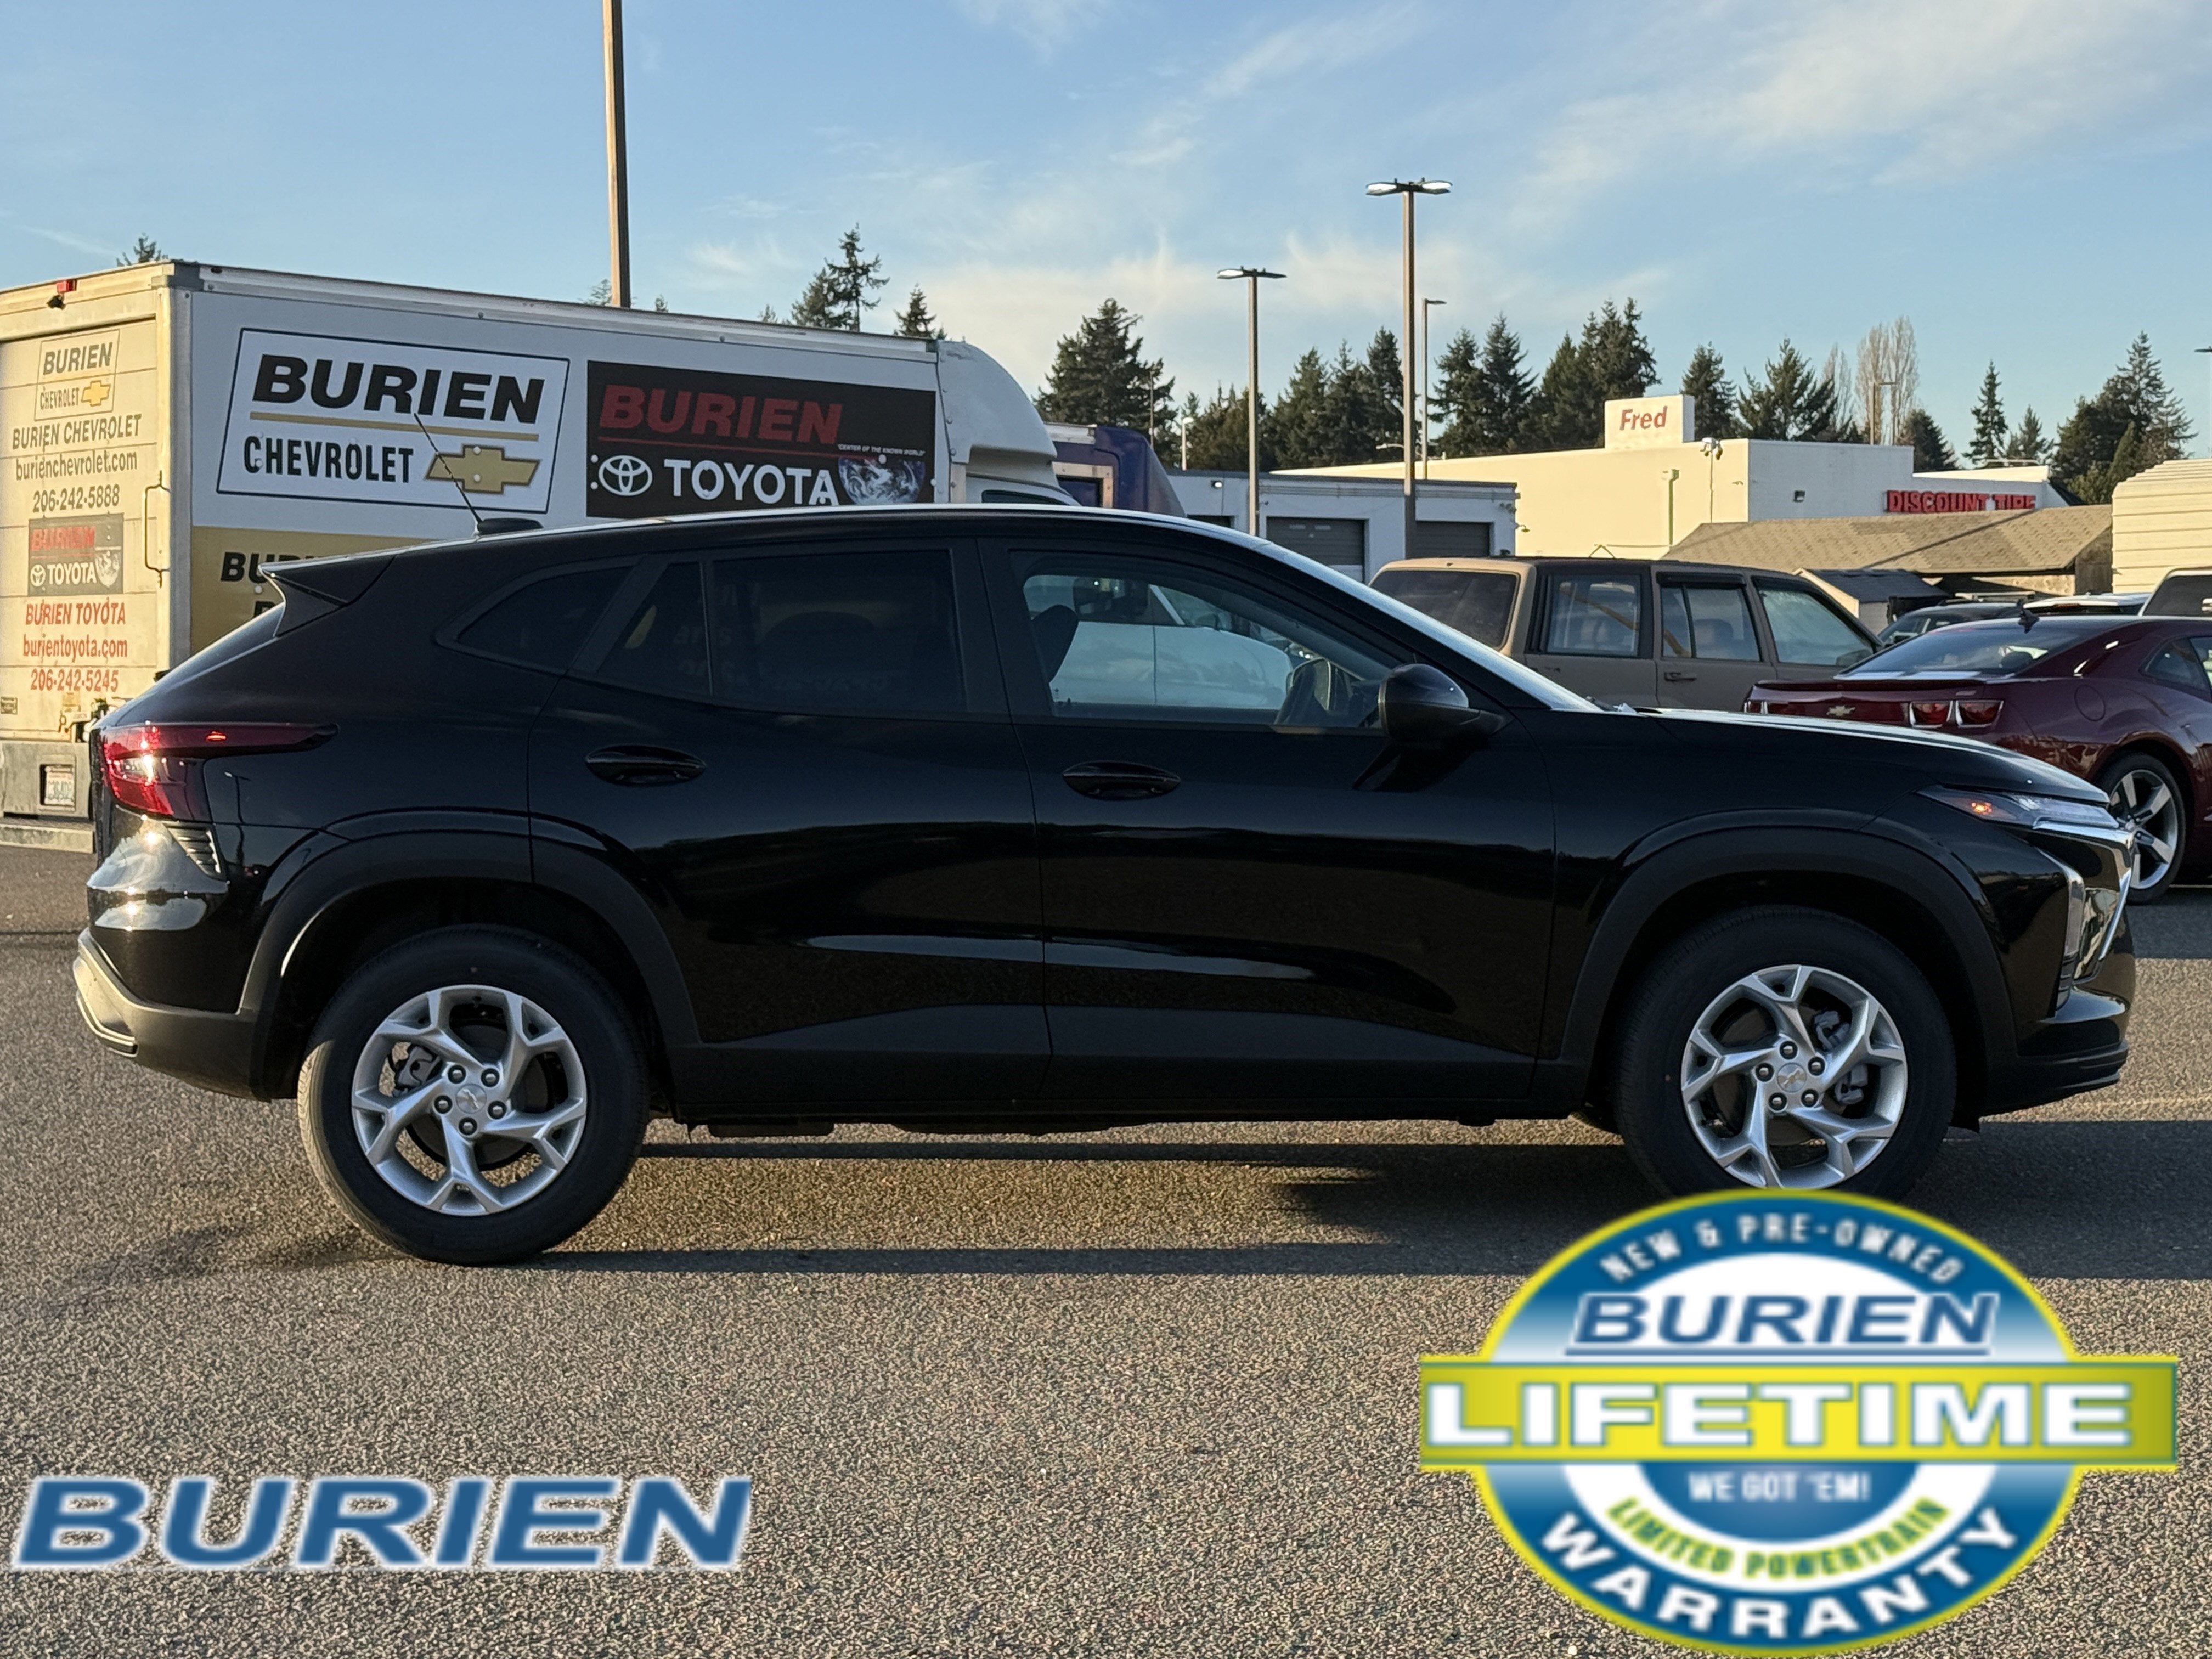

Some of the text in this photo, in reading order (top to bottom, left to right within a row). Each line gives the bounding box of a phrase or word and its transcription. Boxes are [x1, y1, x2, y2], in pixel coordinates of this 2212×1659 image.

[43, 342, 113, 375] BURIEN
[40, 387, 80, 410] CHEVROLET
[251, 353, 545, 424] BURIEN
[599, 384, 843, 444] BURIEN
[1620, 405, 1668, 431] Fred
[13, 414, 142, 449] BURIEN CHEVROLET
[15, 450, 137, 481] burienchevrolet.com
[244, 436, 414, 483] CHEVROLET
[664, 459, 839, 506] TOYOTA
[1886, 490, 1990, 514] DISCOUNT
[31, 526, 95, 551] BURIEN
[47, 561, 97, 585] TOYOTA
[25, 602, 126, 625] BURIEN TOYOTA
[23, 633, 128, 663] burientoyota.com
